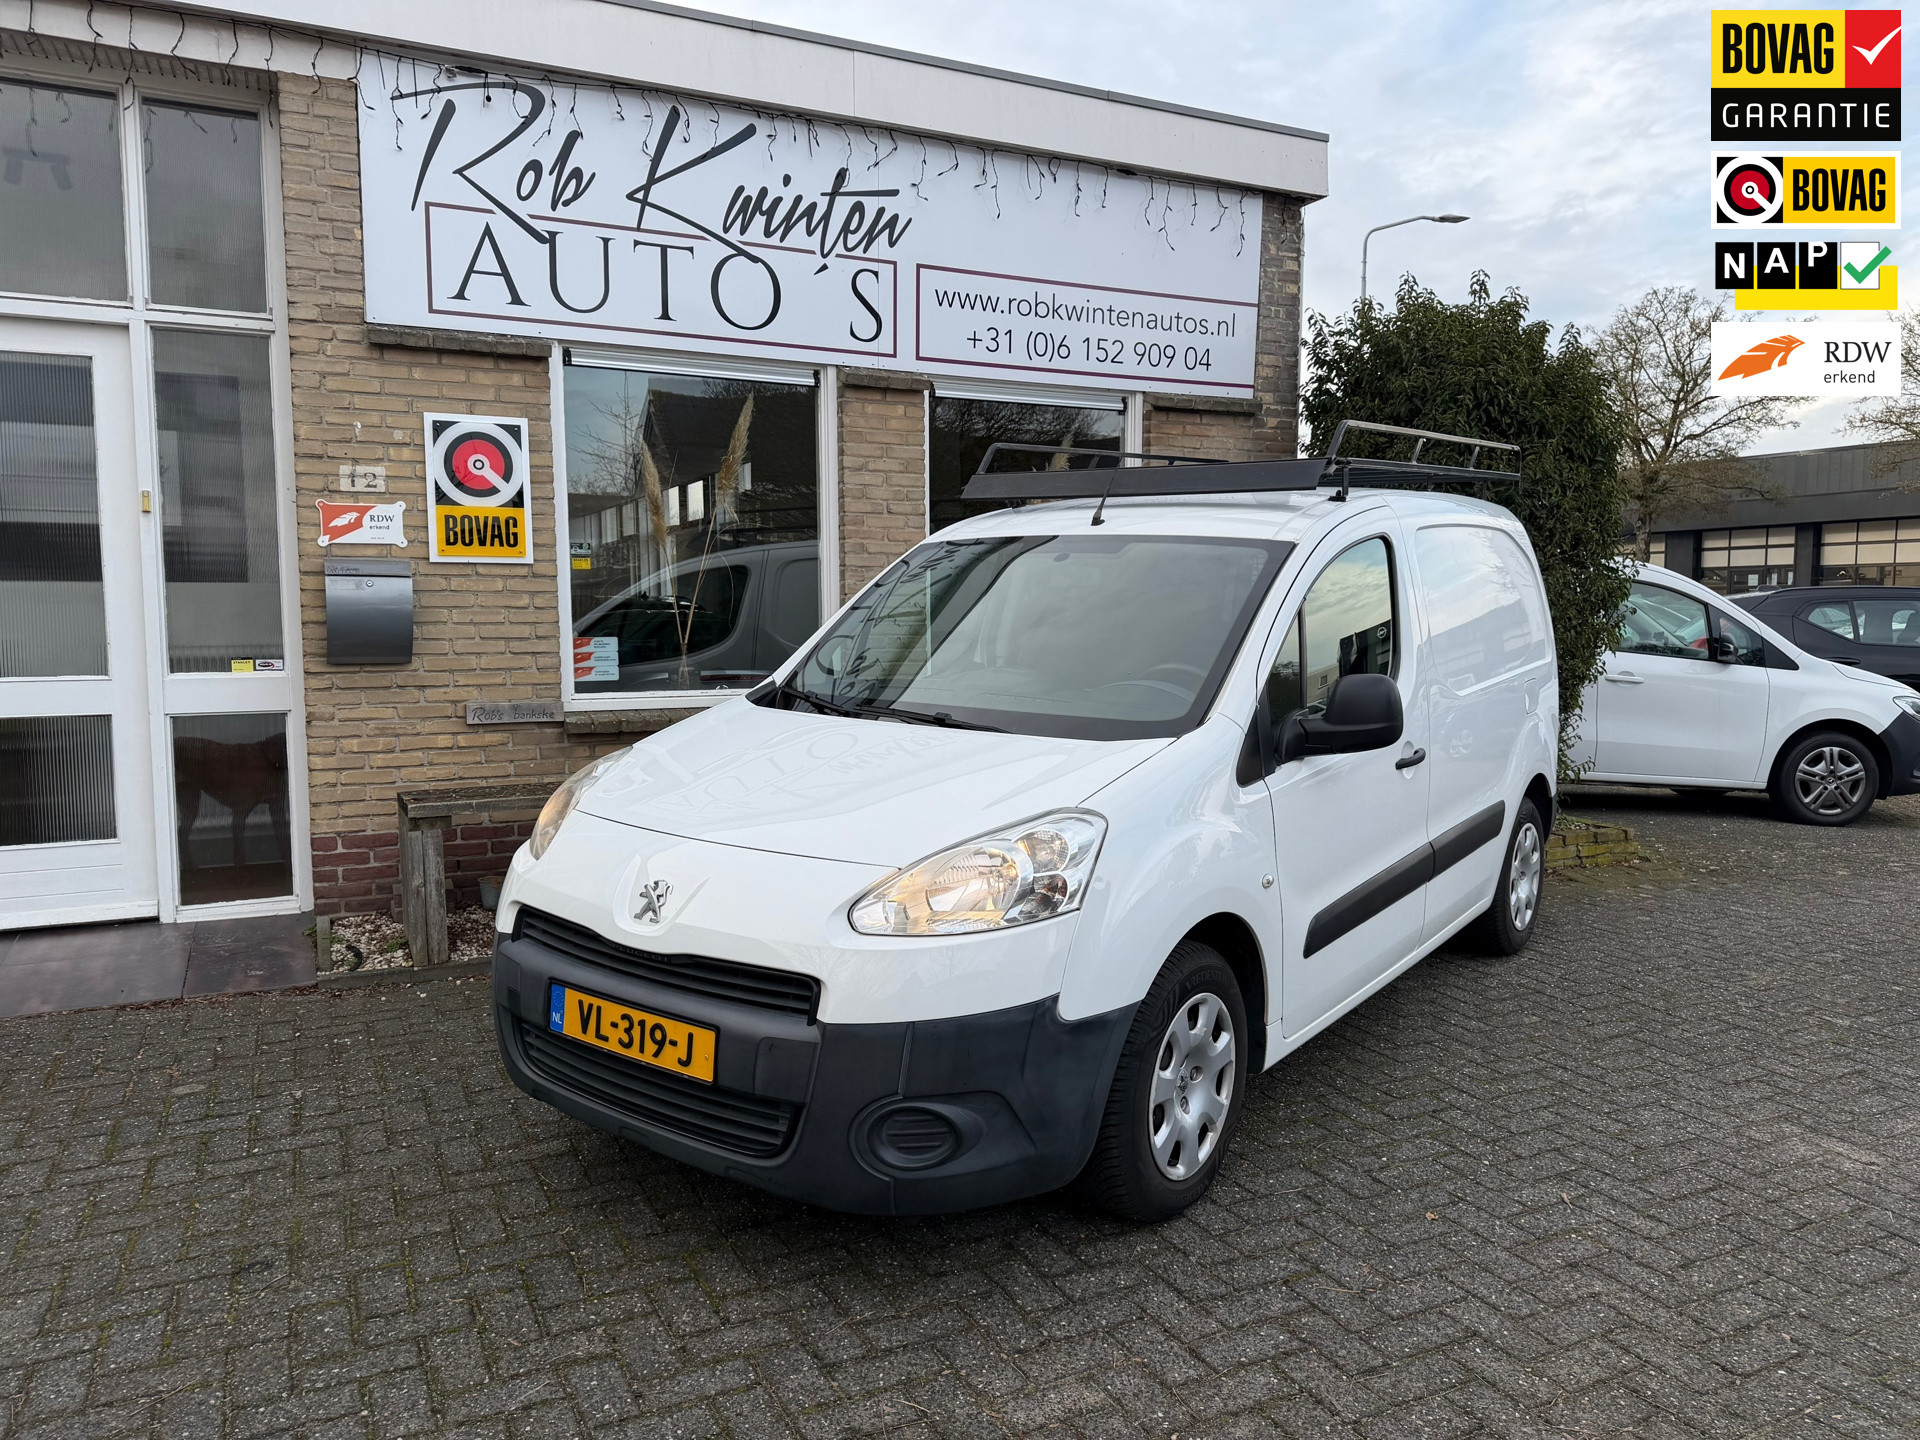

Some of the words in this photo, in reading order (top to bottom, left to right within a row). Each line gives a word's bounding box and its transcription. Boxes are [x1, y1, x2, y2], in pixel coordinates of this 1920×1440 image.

[390, 82, 596, 245] Rob
[626, 105, 912, 265] Kwinten
[934, 288, 1237, 338] www.robkwintenautos.nl
[966, 326, 1014, 356] +31
[1026, 330, 1071, 363] (0)6
[1082, 336, 1124, 365] 152
[1134, 341, 1176, 369] 909
[1184, 346, 1212, 372] 04
[369, 514, 395, 523] RDW
[444, 514, 519, 548] BOVAG
[552, 1011, 563, 1025] NL
[577, 998, 694, 1068] VL-319-J
